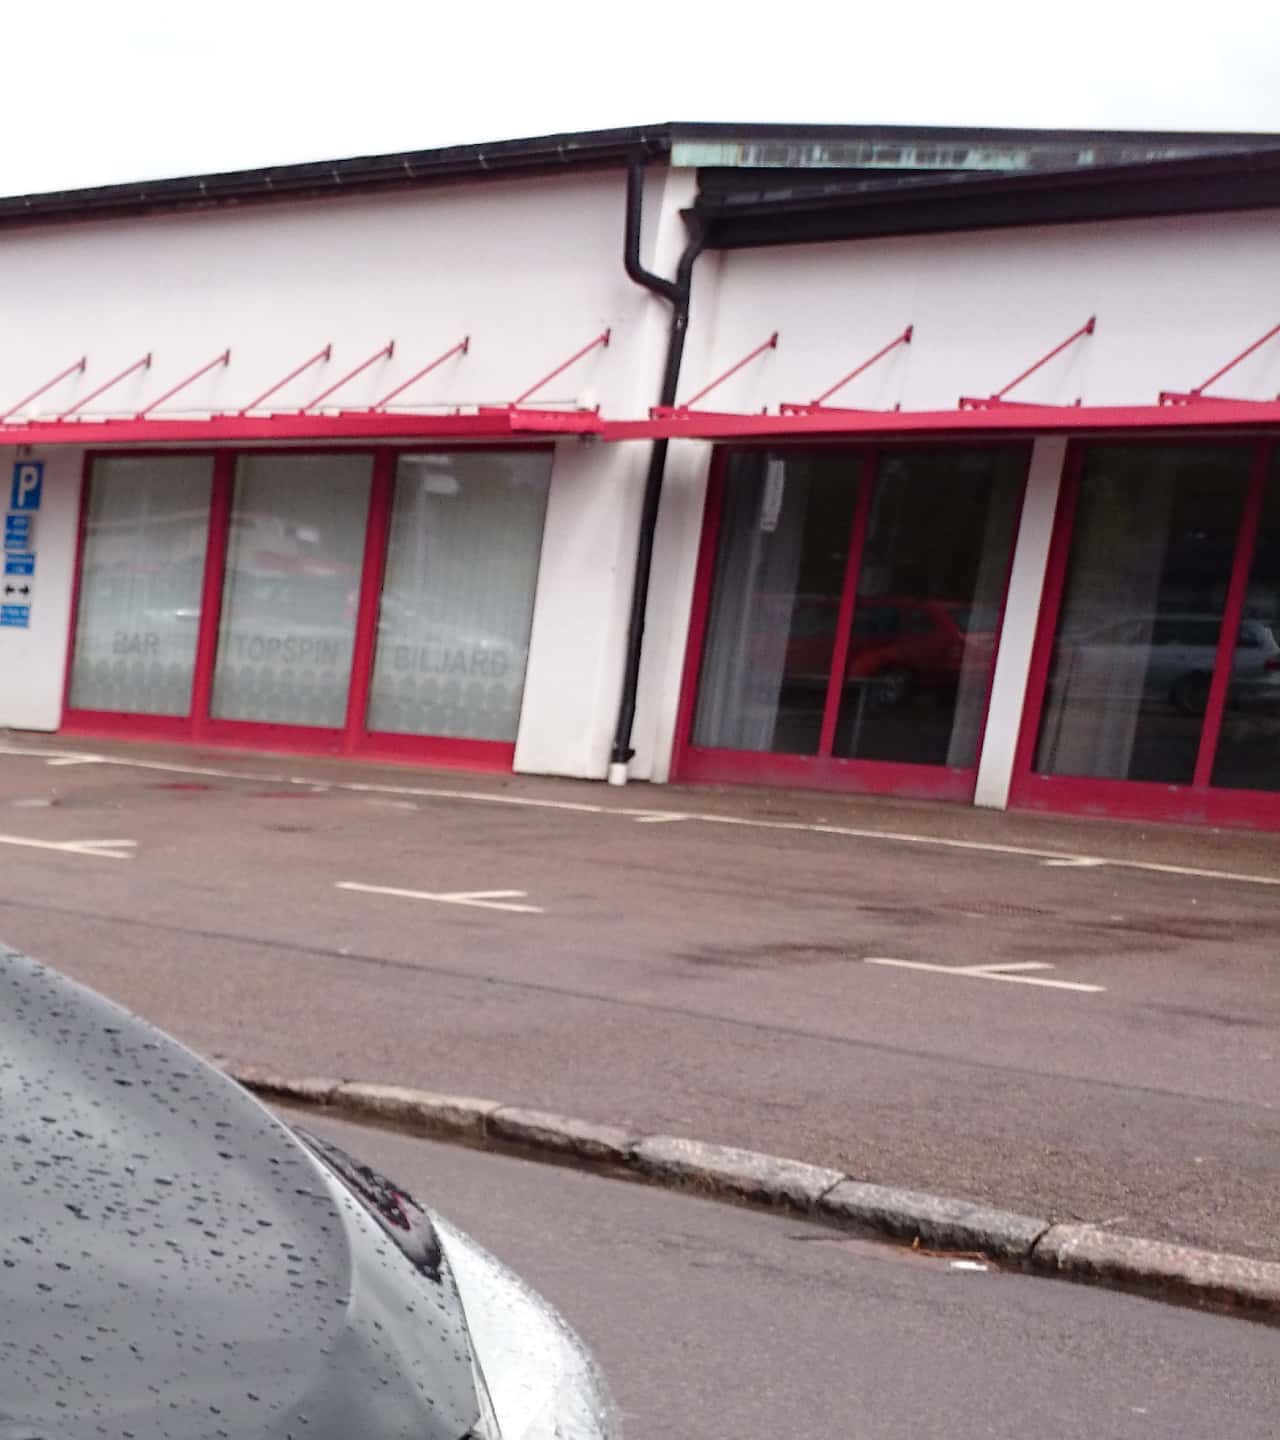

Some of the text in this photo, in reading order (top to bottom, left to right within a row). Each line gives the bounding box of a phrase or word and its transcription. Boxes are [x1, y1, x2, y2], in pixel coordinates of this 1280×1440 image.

[17, 465, 39, 508] P
[112, 631, 161, 657] BAR
[233, 633, 340, 667] TOPSPIN
[393, 644, 511, 678] BILJARD
